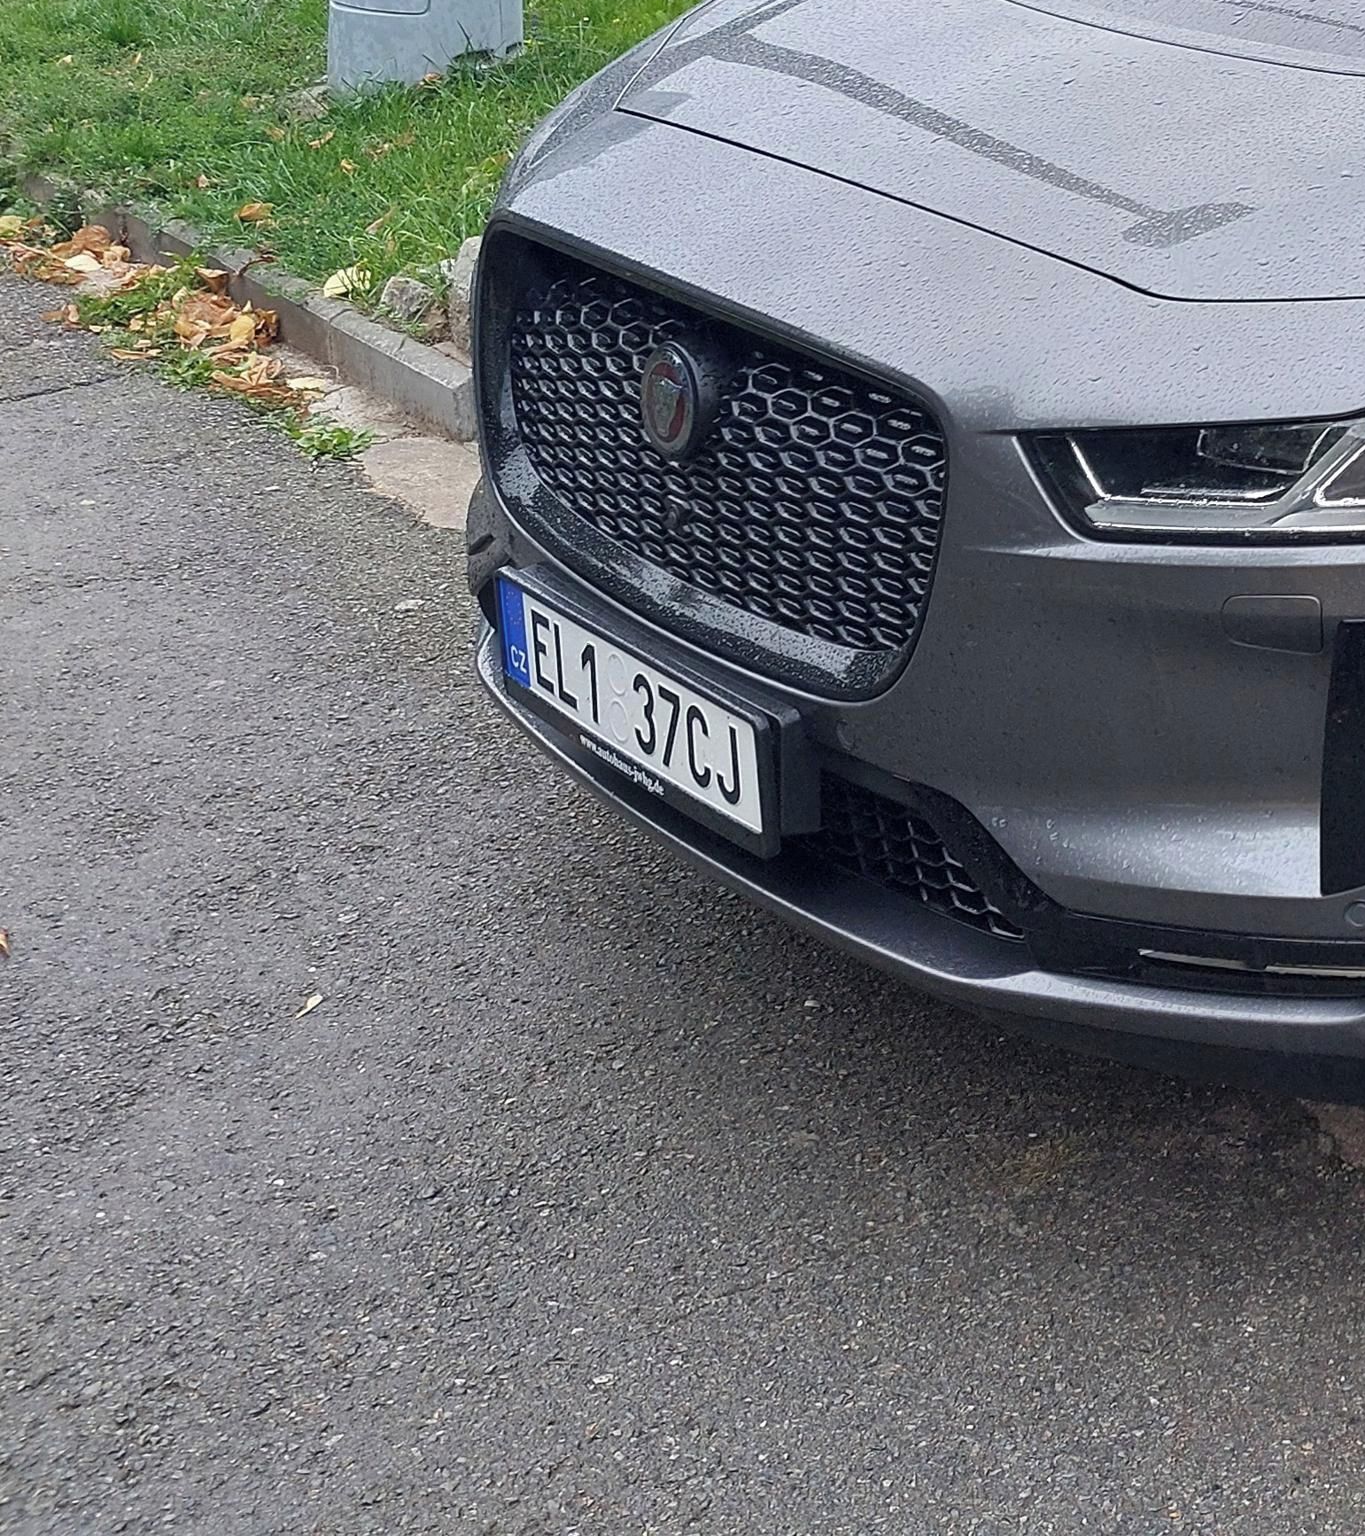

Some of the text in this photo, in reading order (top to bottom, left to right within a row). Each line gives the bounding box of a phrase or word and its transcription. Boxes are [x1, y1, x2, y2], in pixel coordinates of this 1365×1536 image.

[510, 644, 528, 675] CZ
[530, 607, 743, 806] EL1 37CJ
